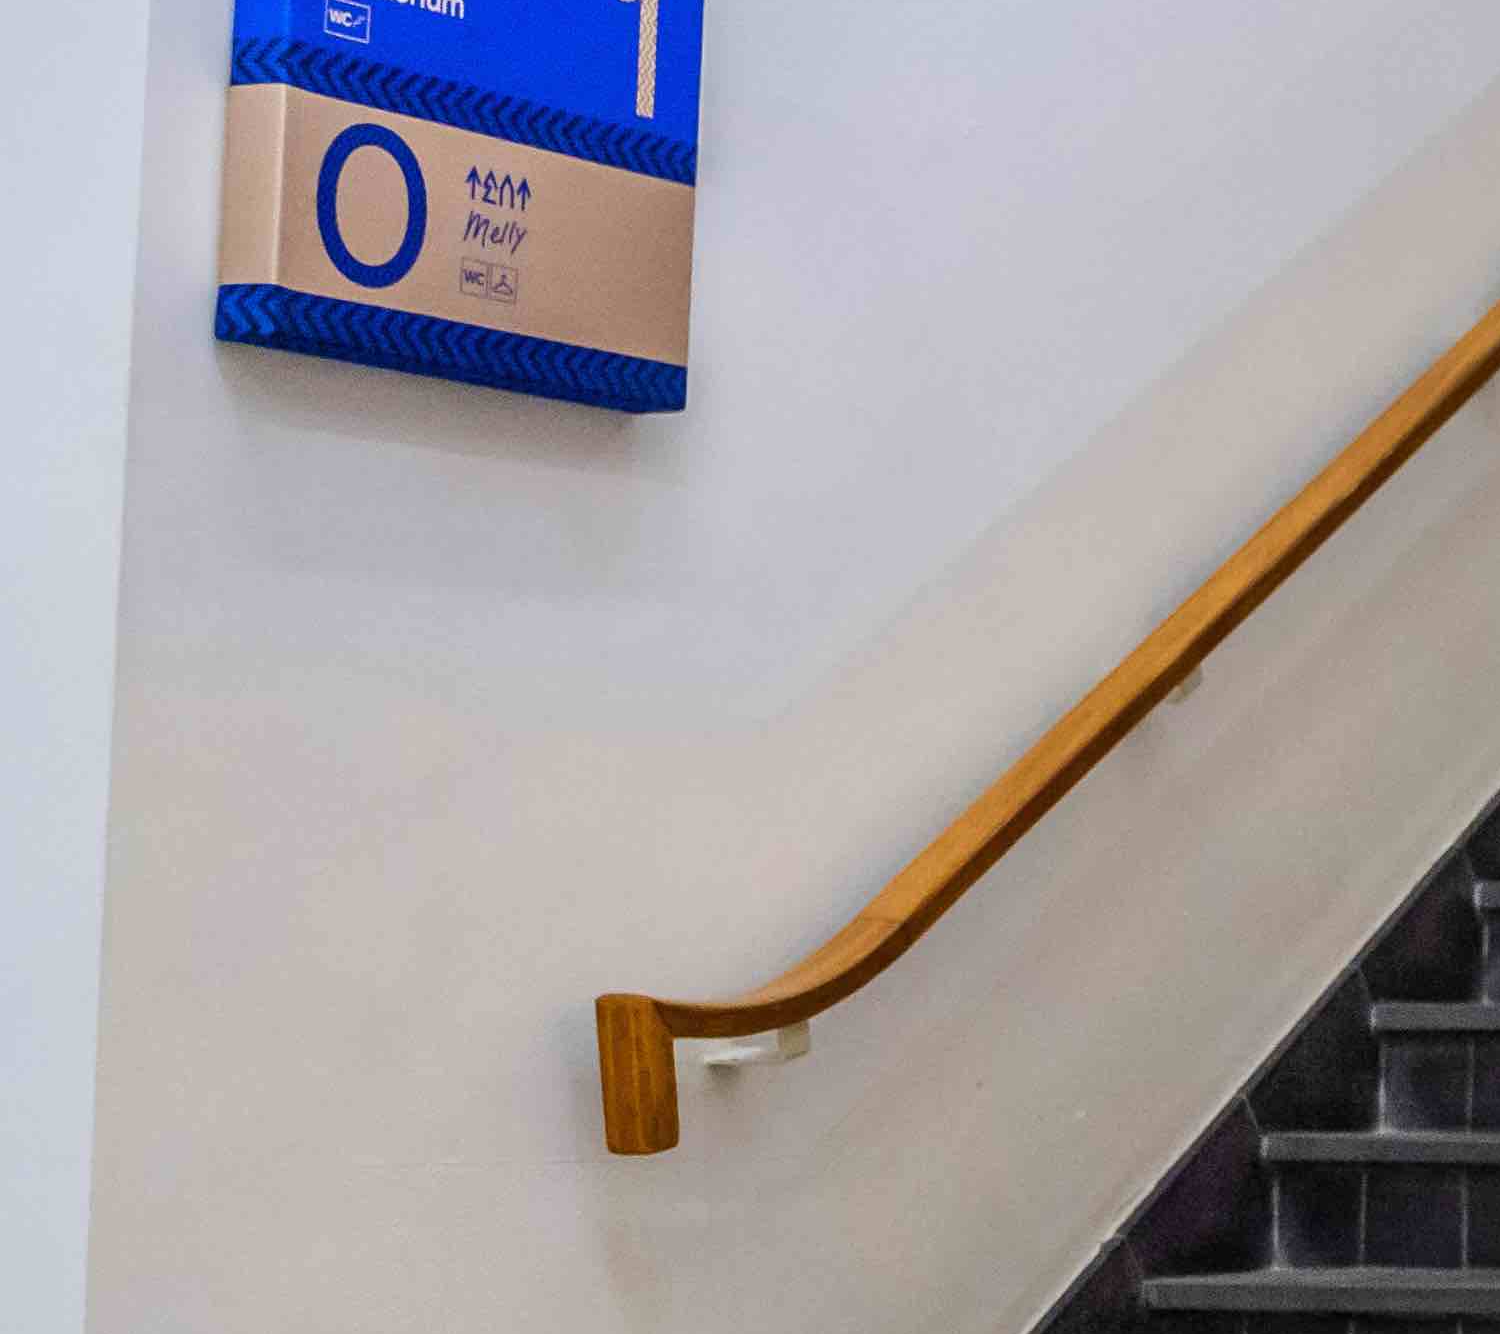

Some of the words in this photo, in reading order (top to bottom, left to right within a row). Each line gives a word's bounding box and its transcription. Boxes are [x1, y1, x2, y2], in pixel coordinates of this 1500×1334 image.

[329, 7, 352, 28] WC
[464, 211, 528, 255] Melly
[464, 269, 485, 285] WC
